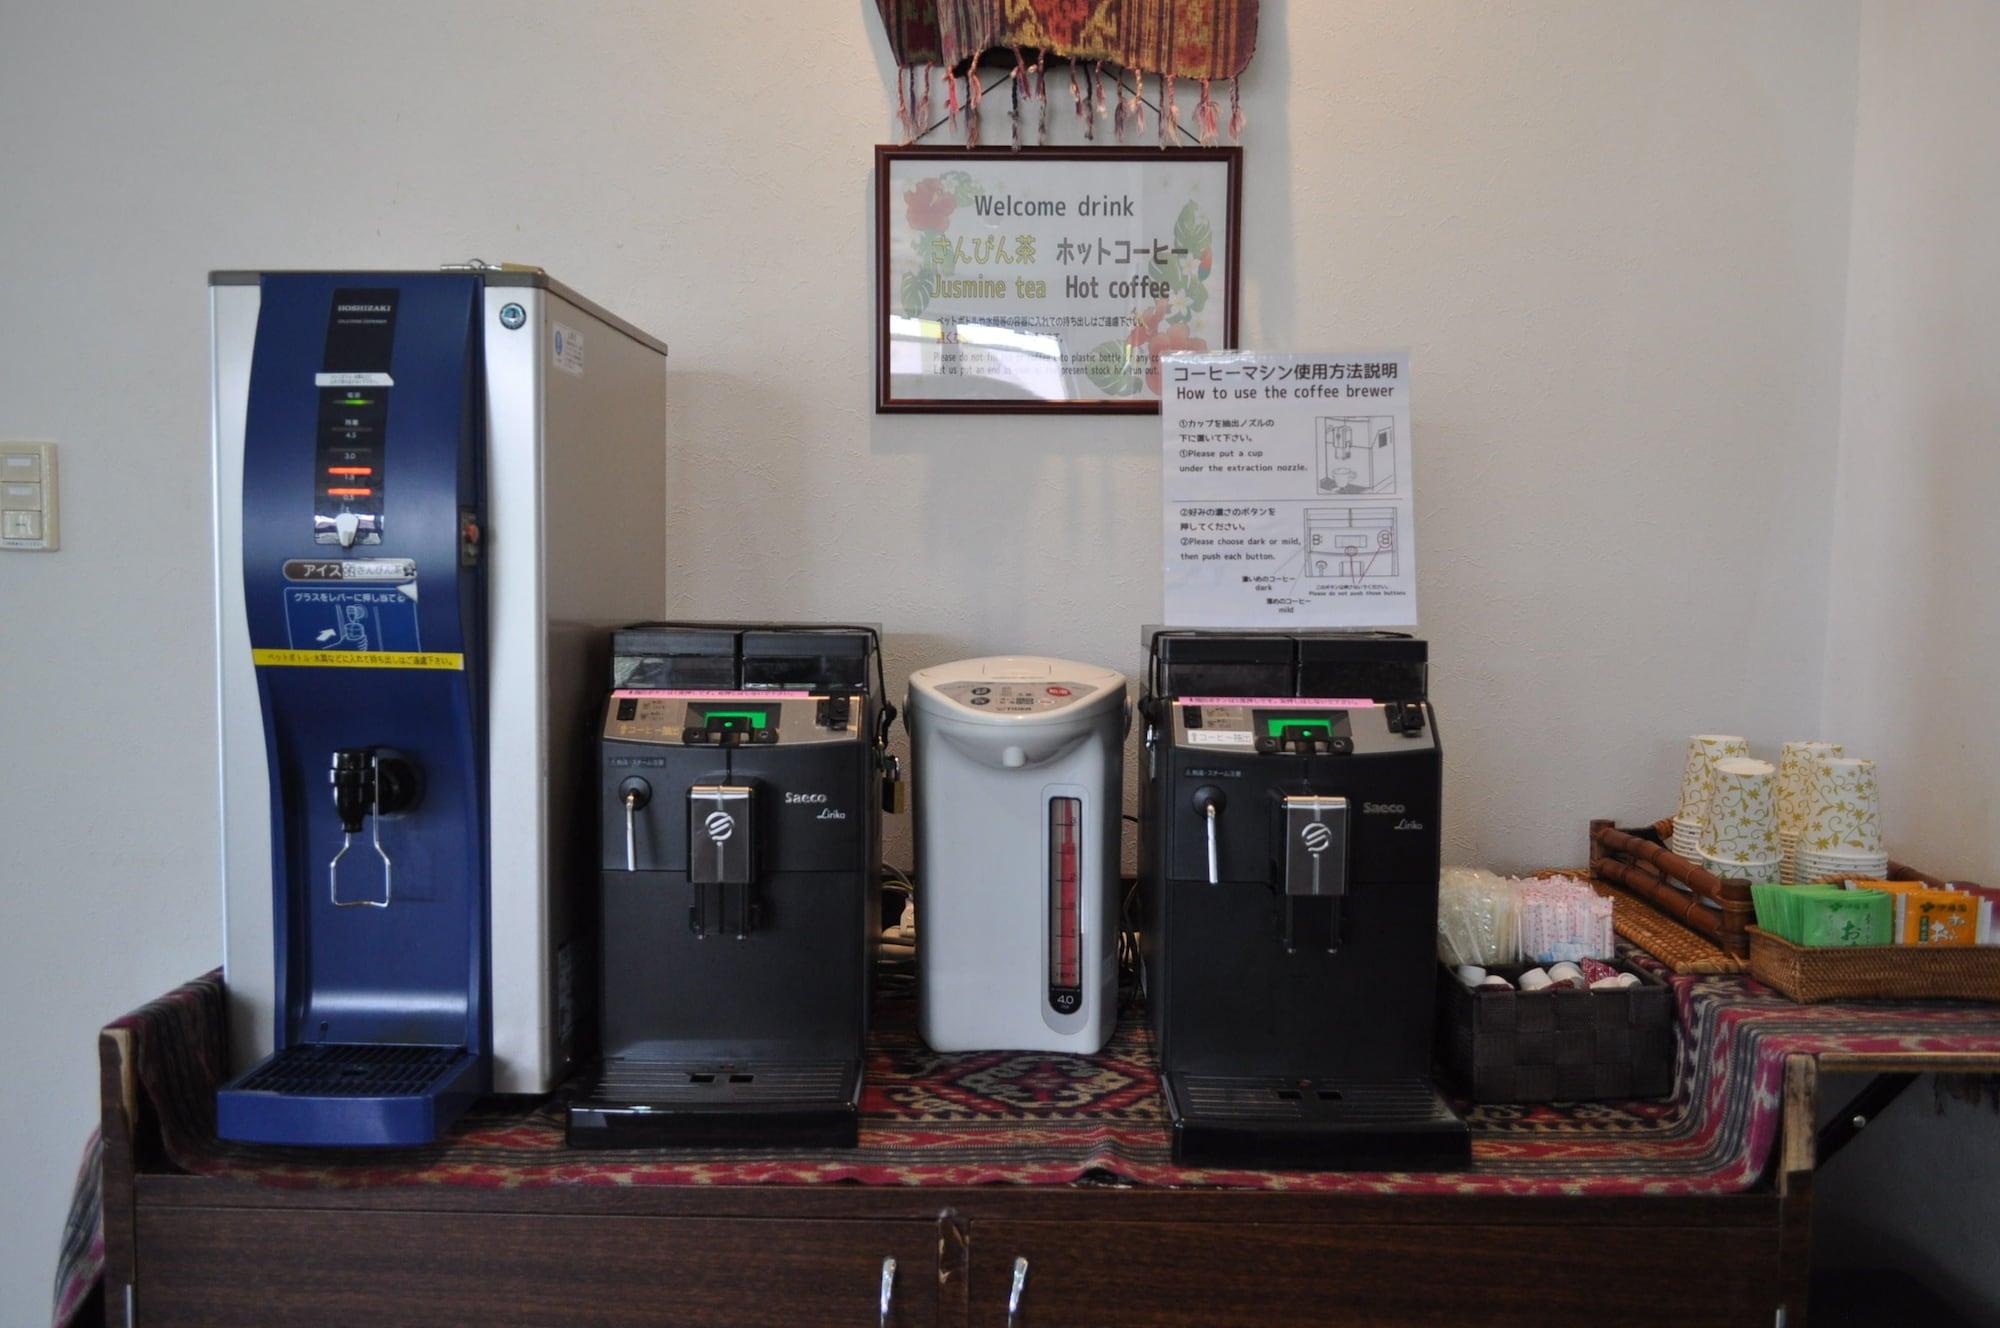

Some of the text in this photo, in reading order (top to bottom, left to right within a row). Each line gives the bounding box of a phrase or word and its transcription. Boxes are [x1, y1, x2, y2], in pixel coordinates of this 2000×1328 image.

[975, 194, 1135, 217] Welcome drink
[1056, 237, 1188, 265] ホットコーヒー
[931, 273, 1171, 299] Jusmine tea Hot coffee
[337, 304, 392, 313] HOSHIZAKI
[1091, 365, 1111, 375] stock
[1174, 362, 1398, 381] コーヒーマシン使用方法説明
[1177, 384, 1395, 400] How to use the coffee brewer
[1219, 450, 1234, 459] put
[1247, 450, 1264, 459] cup
[1179, 462, 1308, 472] under the extraction nozzle.
[1217, 537, 1244, 545] choose
[1247, 537, 1265, 545] dark
[1180, 552, 1276, 562] then push each button.
[303, 564, 342, 578] アイス
[1255, 583, 1272, 591] dark
[1278, 606, 1295, 614] mild
[784, 791, 827, 804] Saeco
[1363, 801, 1405, 814] Saeco
